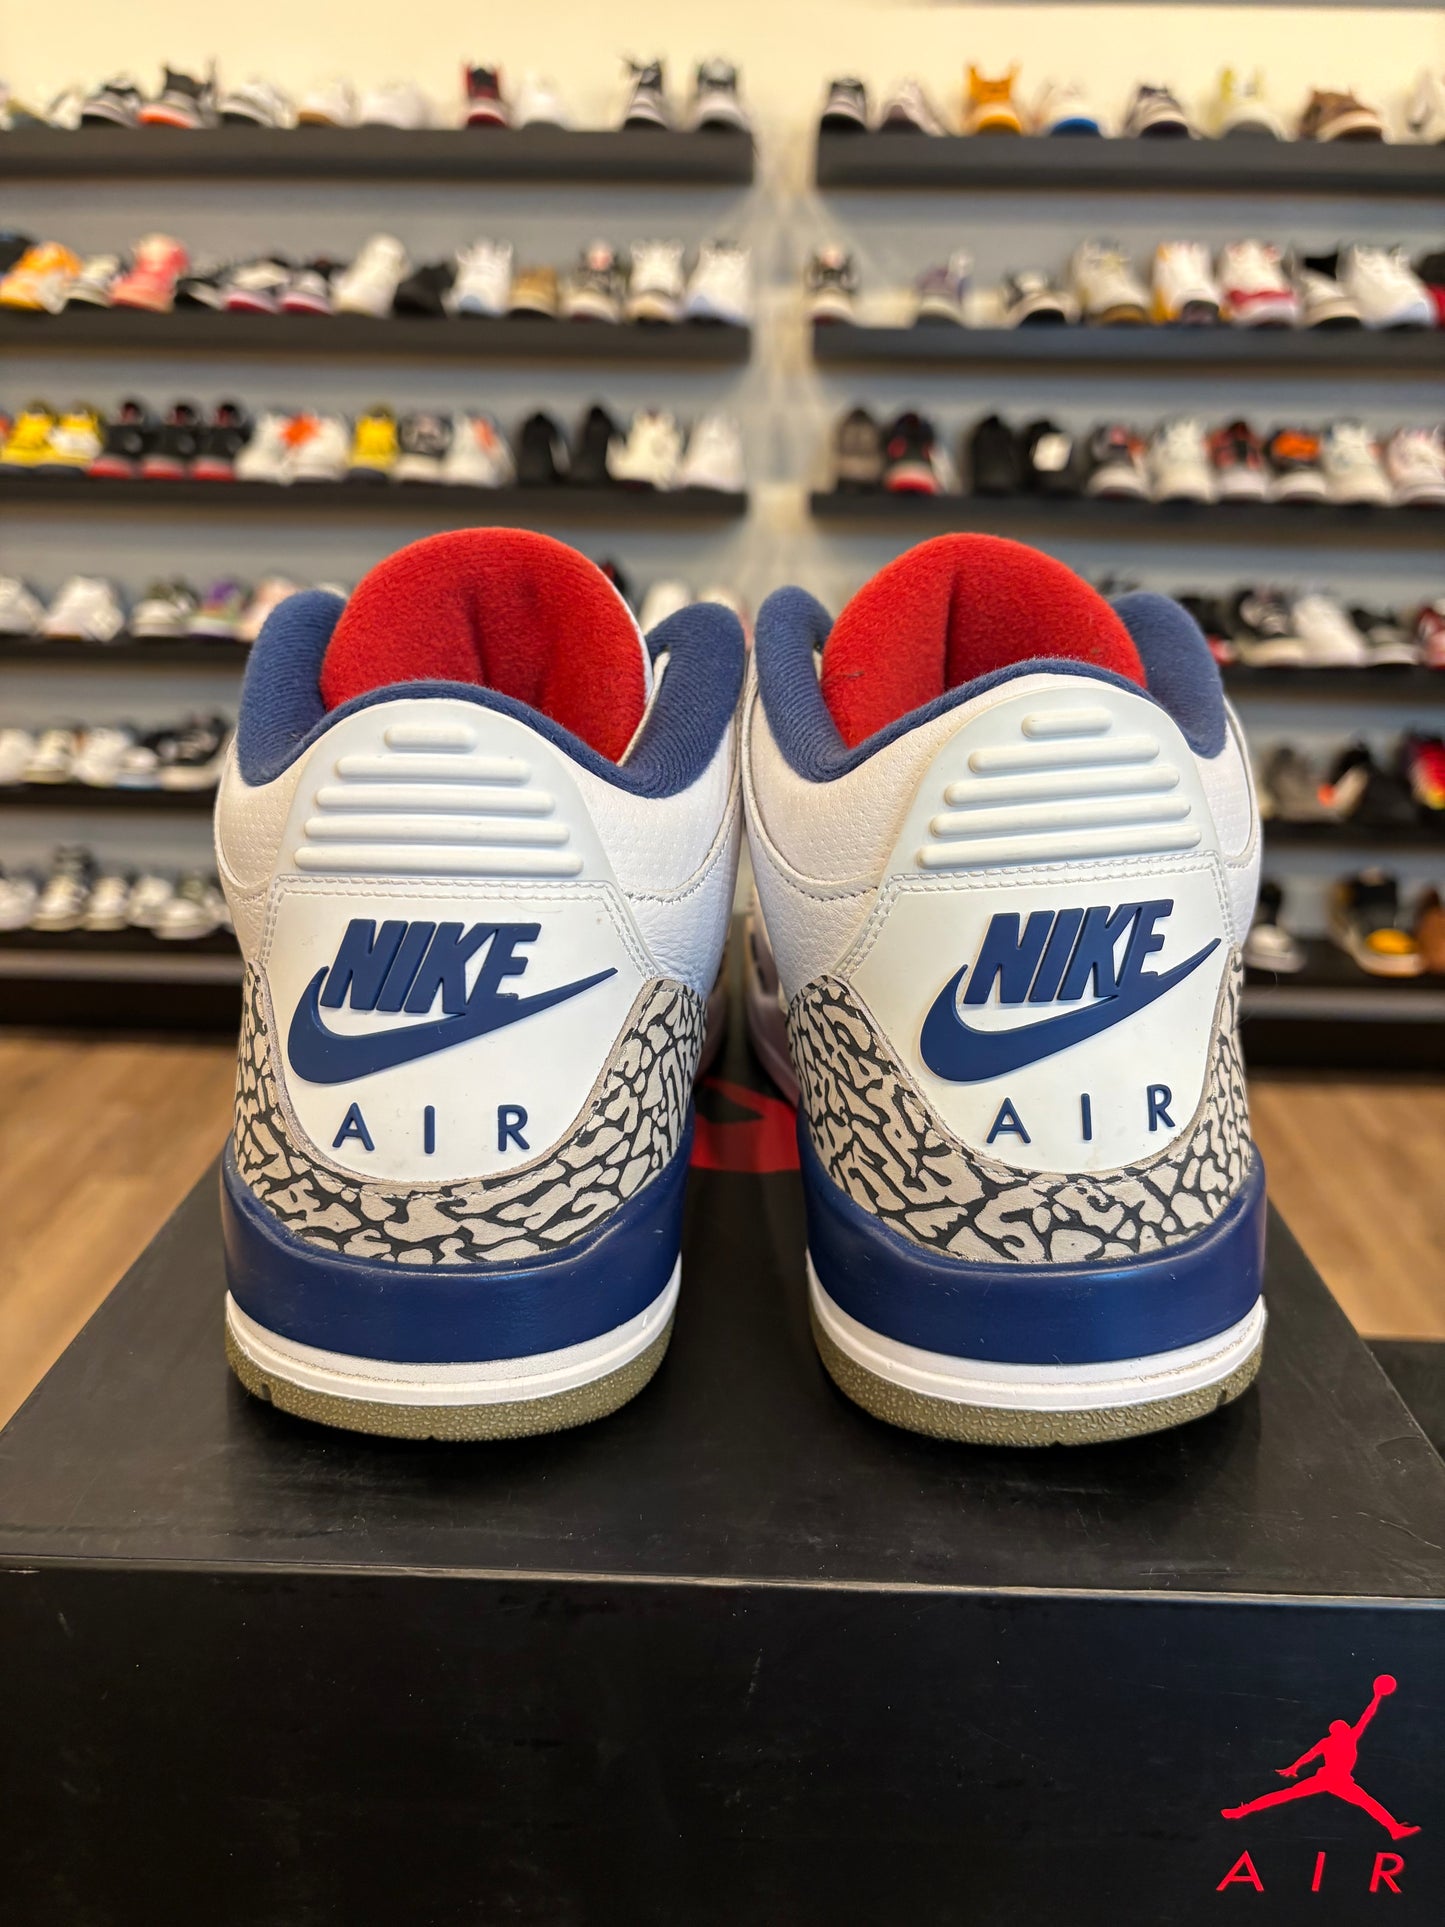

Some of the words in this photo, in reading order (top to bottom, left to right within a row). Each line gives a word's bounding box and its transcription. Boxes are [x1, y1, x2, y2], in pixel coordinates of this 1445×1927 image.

[320, 918, 542, 1014] NIKE
[963, 899, 1174, 1005] NIKE
[332, 1102, 530, 1154] AIR
[986, 1084, 1176, 1144] AIR
[1216, 1850, 1405, 1893] AIR
